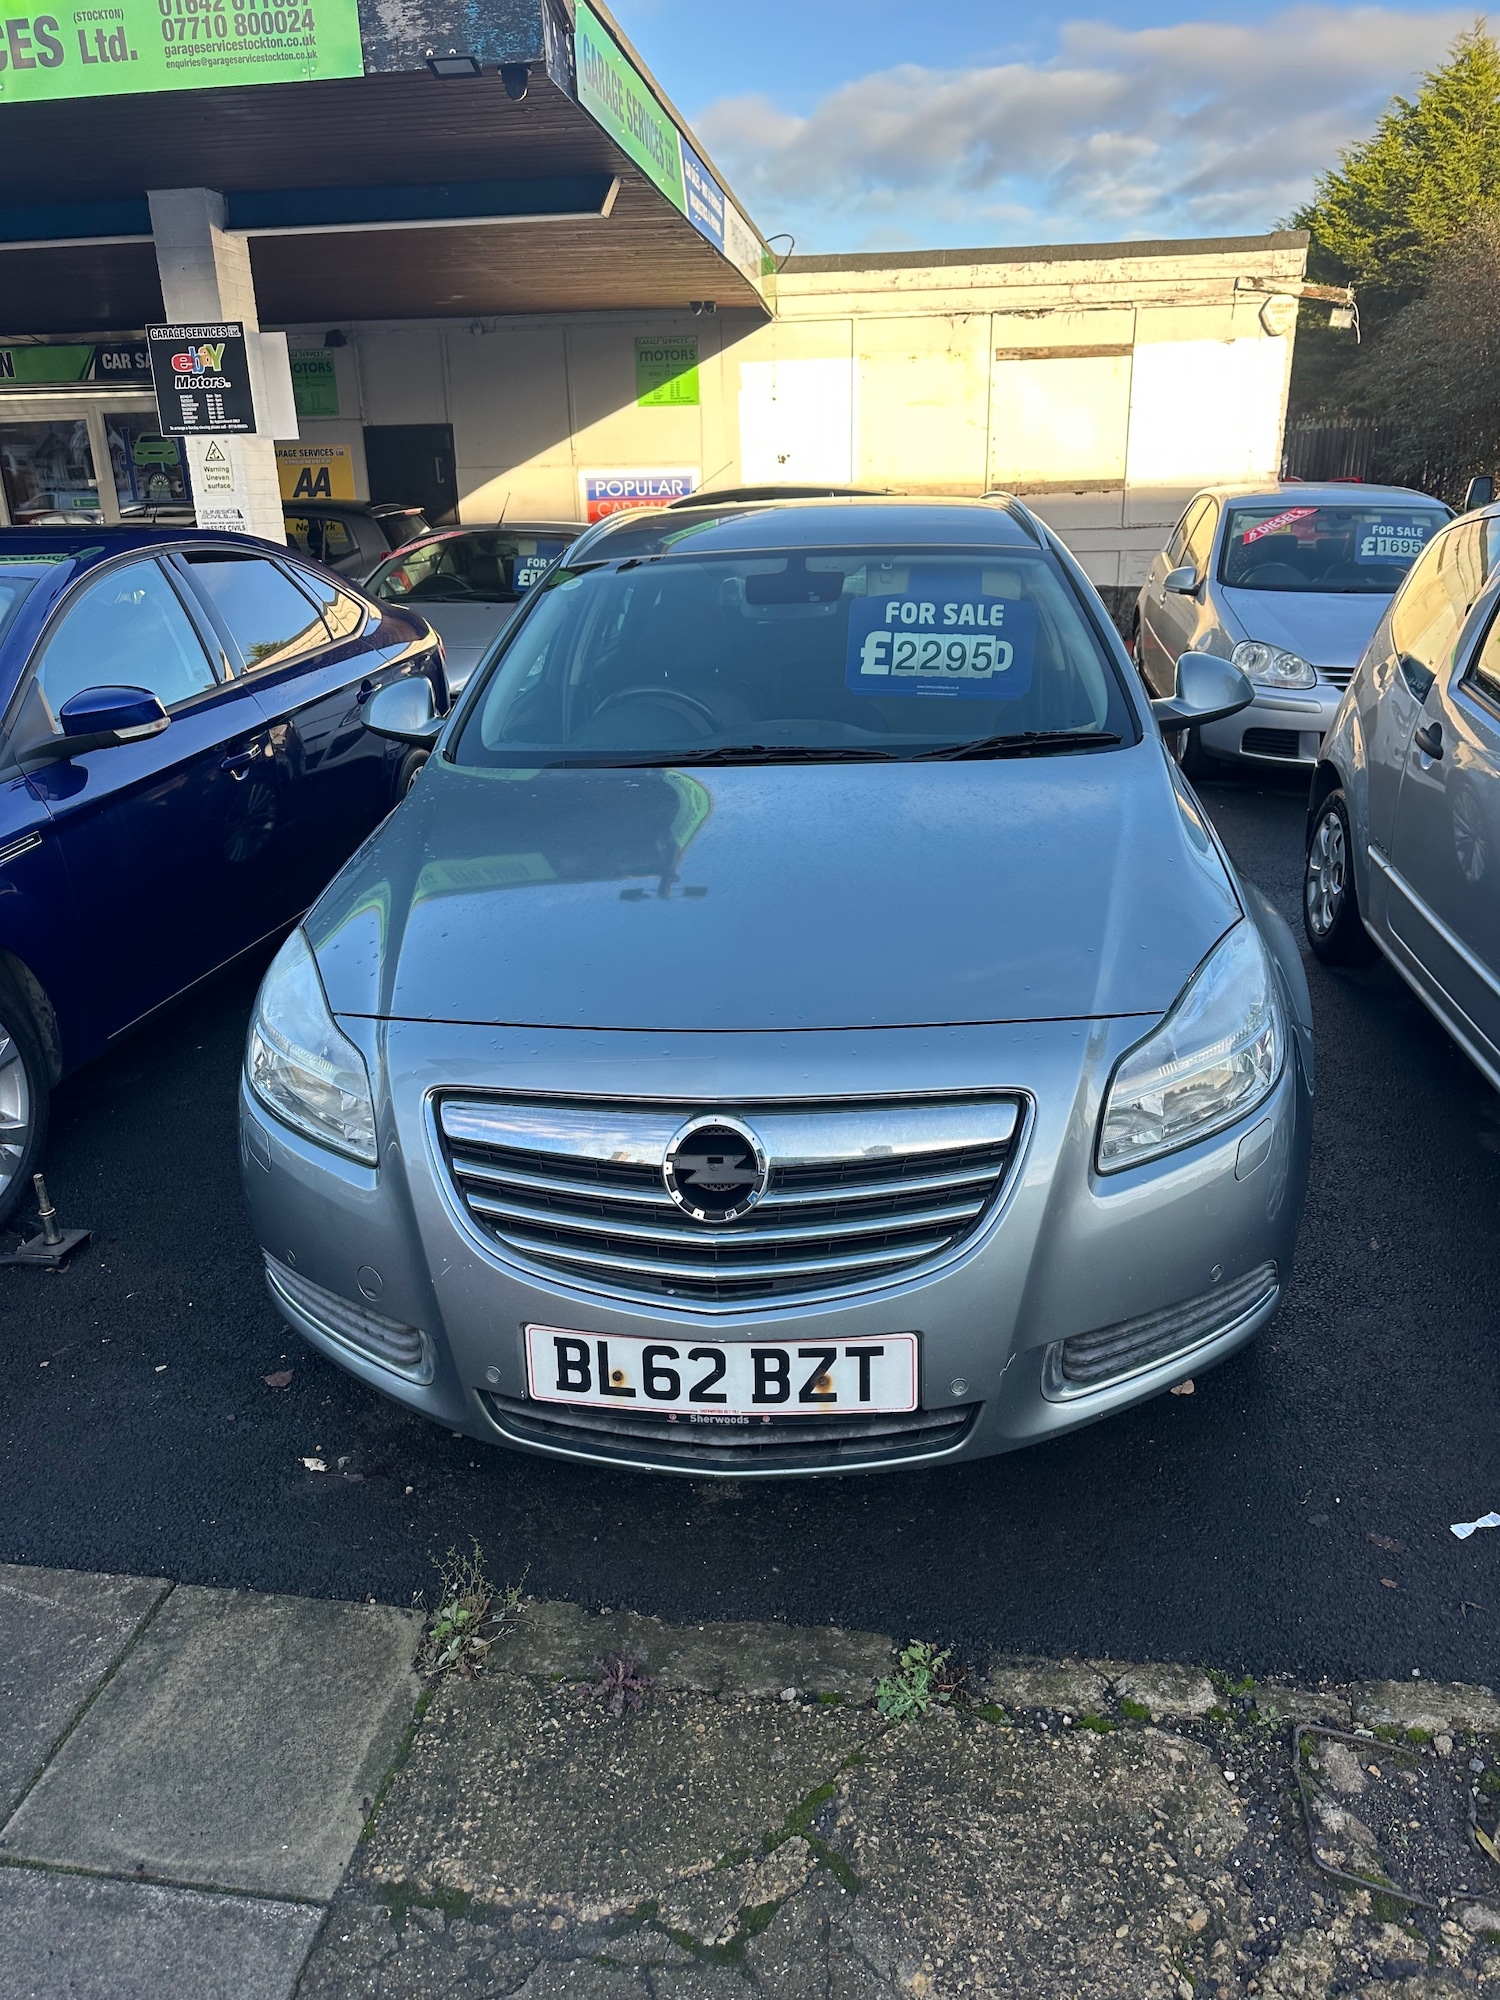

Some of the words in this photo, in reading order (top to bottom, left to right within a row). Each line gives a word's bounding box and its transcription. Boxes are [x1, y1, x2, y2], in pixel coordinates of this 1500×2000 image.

[73, 8, 124, 24] (STOCKTON)
[161, 14, 228, 42] 07710
[234, 8, 315, 37] 800024
[0, 15, 64, 71] ES
[77, 26, 138, 64] Ltd.
[164, 33, 316, 58] garageservicestockton.co.uk
[166, 50, 318, 69] enquiries@garageservicestockton.co.uk
[583, 33, 625, 123] GARAGE
[626, 87, 664, 167] SERVICES
[151, 328, 185, 340] GARAGE
[186, 326, 227, 338] SERVICES
[102, 353, 132, 369] CAR
[640, 349, 696, 361] MOTORS
[293, 362, 332, 373] OTORS
[175, 375, 225, 389] Motors
[299, 448, 334, 457] SERVICES
[293, 467, 331, 497] AA
[595, 479, 683, 497] POPULAR
[1257, 511, 1300, 534] DIESEL
[1372, 525, 1394, 535] FOR
[1397, 526, 1424, 537] SALE
[1361, 536, 1421, 556] £1695
[527, 557, 547, 567] FOR
[885, 601, 936, 625] FOR
[943, 603, 1005, 626] SALE
[553, 1336, 728, 1403] BL62
[750, 1346, 884, 1403] BZT
[690, 1414, 750, 1424] Sherwoods
